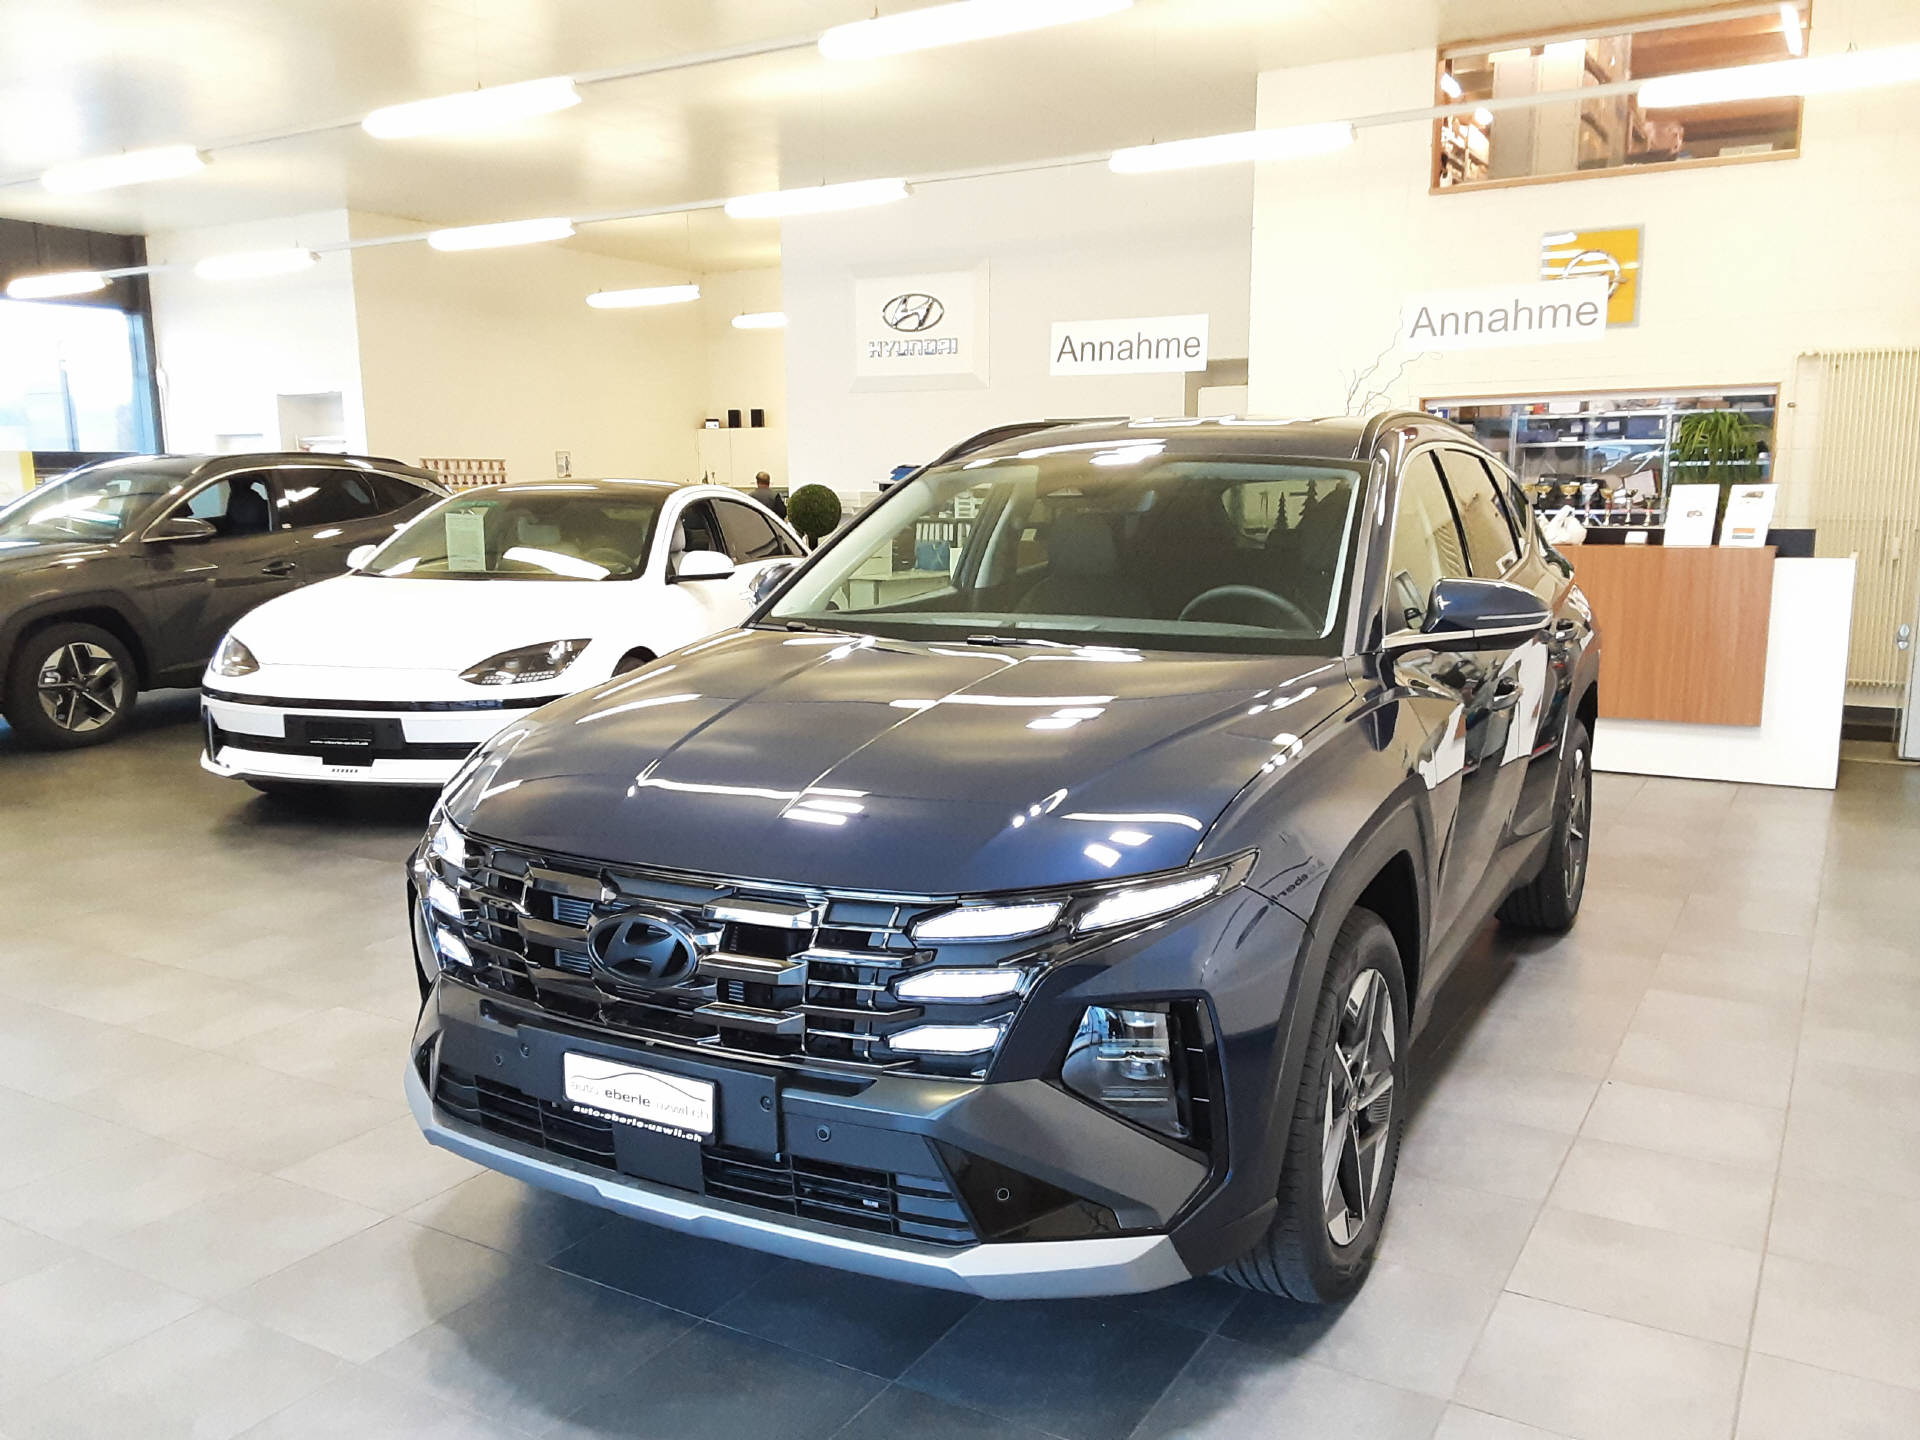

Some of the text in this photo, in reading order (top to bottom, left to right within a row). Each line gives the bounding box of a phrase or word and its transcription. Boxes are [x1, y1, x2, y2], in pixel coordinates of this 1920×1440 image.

[1409, 299, 1600, 338] Annahme
[868, 337, 959, 358] HYUNDAI
[1056, 331, 1202, 363] Annahme
[604, 1088, 651, 1108] eberle
[572, 1104, 703, 1143] auto-eberle-uzwil.ch
